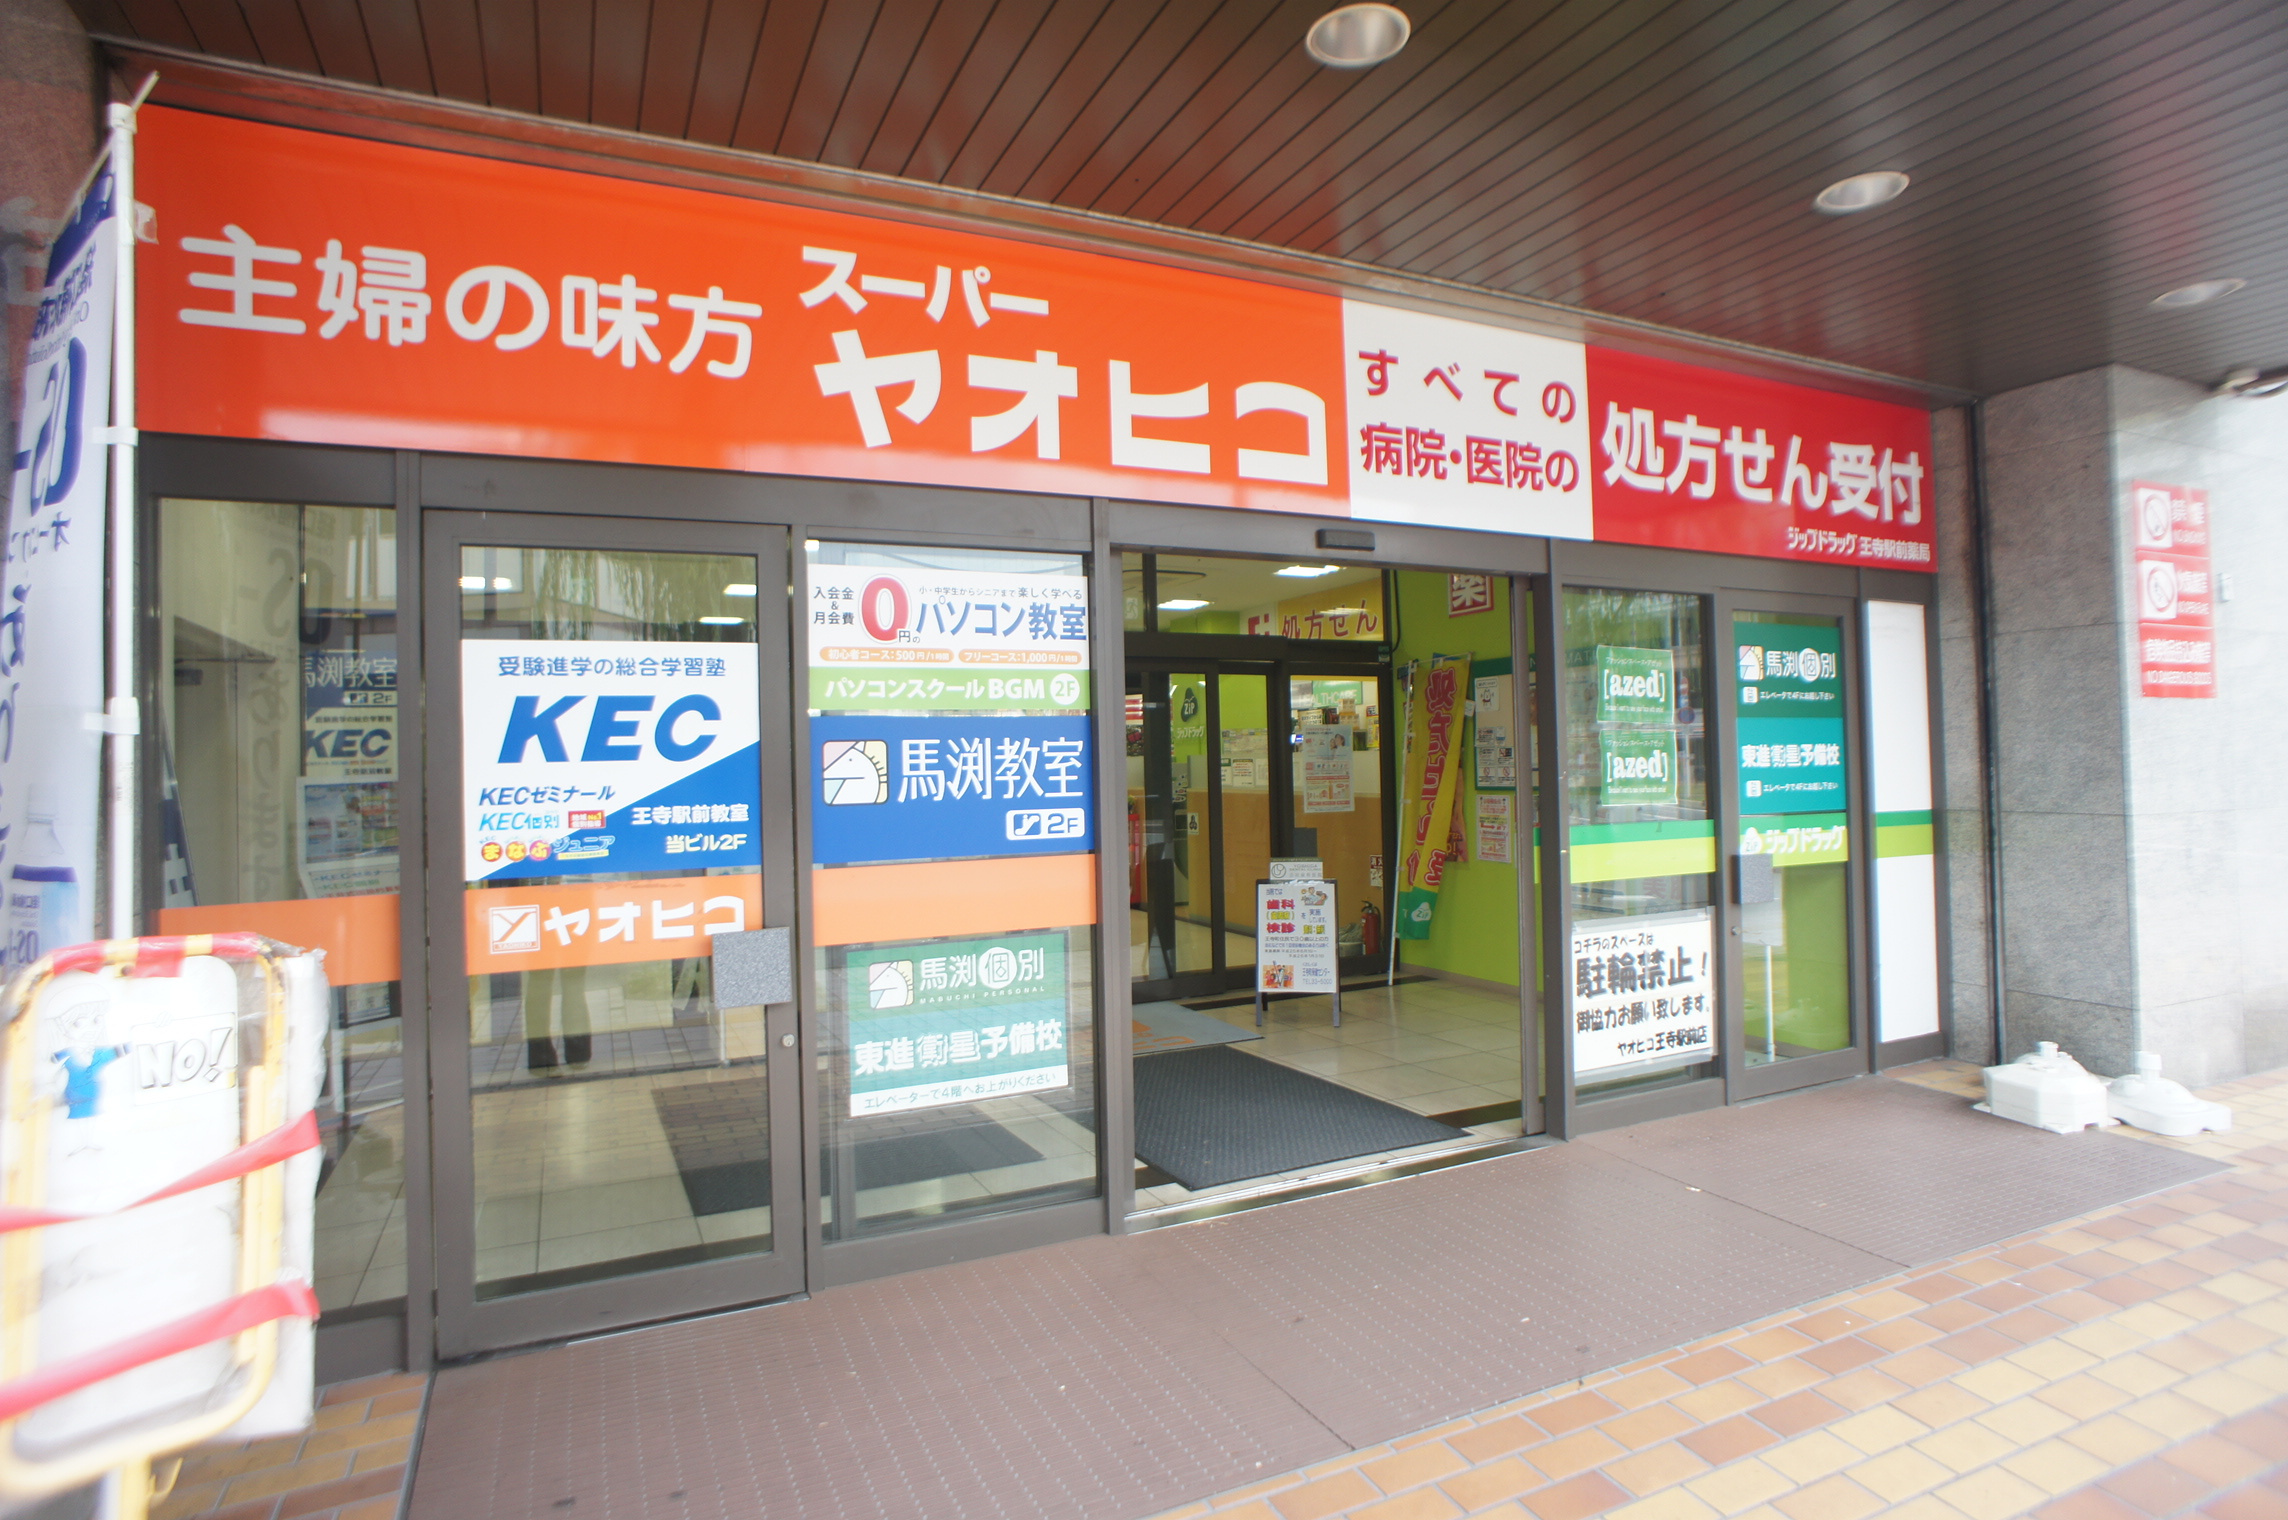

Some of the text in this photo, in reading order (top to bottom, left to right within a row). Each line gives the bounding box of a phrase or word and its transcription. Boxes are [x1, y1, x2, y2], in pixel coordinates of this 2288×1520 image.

[179, 224, 764, 380] 主婦の味方
[798, 244, 1050, 328] スーパー
[1357, 347, 1578, 424] すべての
[813, 328, 1329, 487] ヤオヒコ
[1360, 422, 1580, 494] 病院・医院の
[1600, 400, 1926, 526] 処方せん受付
[1787, 525, 1931, 563] ジップドラッグ 王寺駅前薬局
[813, 586, 854, 600] 入会金
[813, 611, 854, 625] 月会費
[915, 597, 1088, 642] パソコン教室
[498, 656, 727, 678] 受験進学の総合学習塾
[1766, 648, 1837, 682] 馬渕個別
[825, 677, 1080, 700] パソコンスクール BGM 2F
[497, 694, 723, 764] KEC
[897, 736, 1084, 803] 馬渕教室
[1742, 744, 1840, 767] 東進衛星予備校
[478, 785, 616, 806] KECゼミナール
[631, 804, 750, 825] 王寺駅前教室
[1046, 812, 1080, 835] 2F
[1766, 826, 1847, 855] ジップドラッグ
[665, 833, 748, 853] 当ビル2F
[544, 895, 745, 946] ヤオヒコ
[1574, 932, 1654, 954] コチラのスペースは
[919, 946, 1046, 993] 馬渕個別
[919, 985, 1046, 1005] MABUCHI PERSONAL
[1576, 994, 1711, 1034] 御協力お願い致します。
[854, 1017, 1063, 1077] 東進衛星予備校
[1618, 1026, 1709, 1056] ヤオヒコ王寺駅前店
[864, 1071, 1056, 1109] エレベーターで4階へお上がりください
